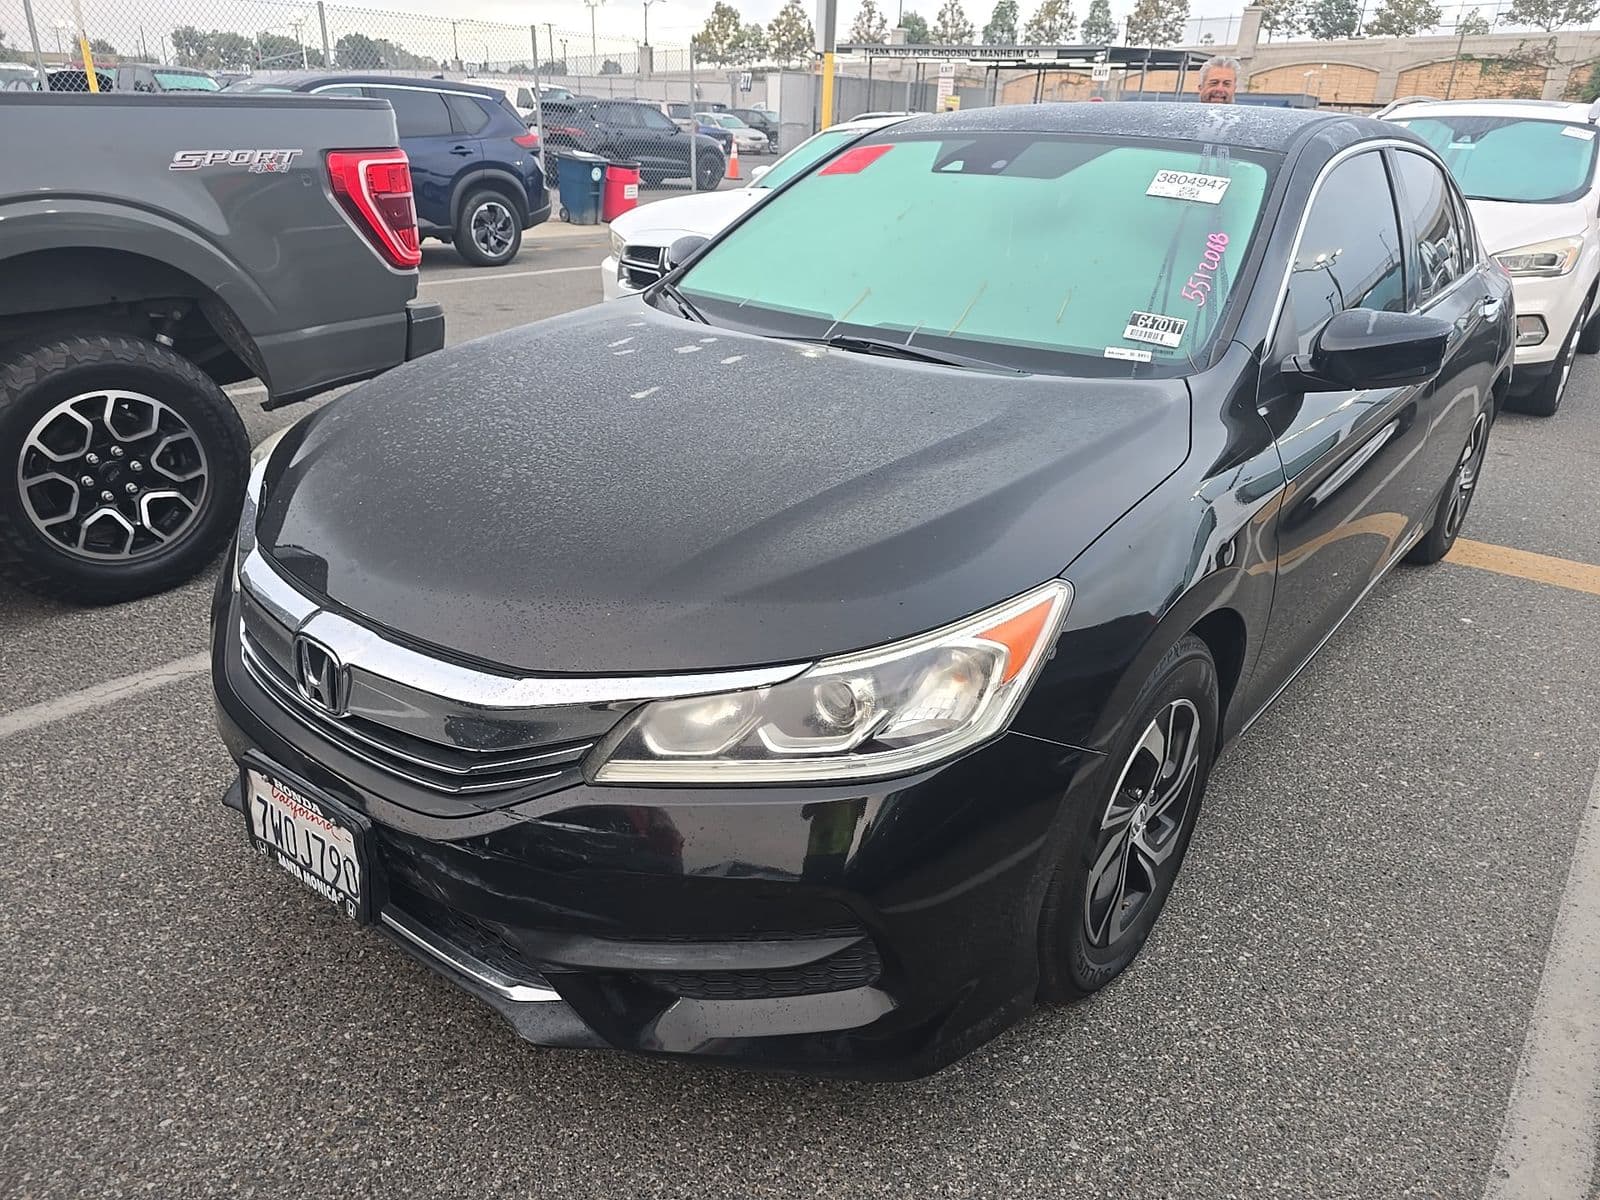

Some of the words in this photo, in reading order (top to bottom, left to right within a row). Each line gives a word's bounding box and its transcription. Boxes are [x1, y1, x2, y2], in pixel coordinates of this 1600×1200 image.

[864, 47, 891, 56] THANK
[894, 48, 911, 56] YOU
[913, 48, 930, 57] FOR
[931, 48, 977, 58] CHOOSING
[980, 49, 1024, 58] MANHEIM
[1027, 49, 1040, 58] CA
[169, 149, 303, 170] SPORT
[1157, 172, 1229, 190] 3804947
[272, 777, 324, 817] HONDA
[271, 785, 341, 841] California
[302, 869, 339, 904] MONICA
